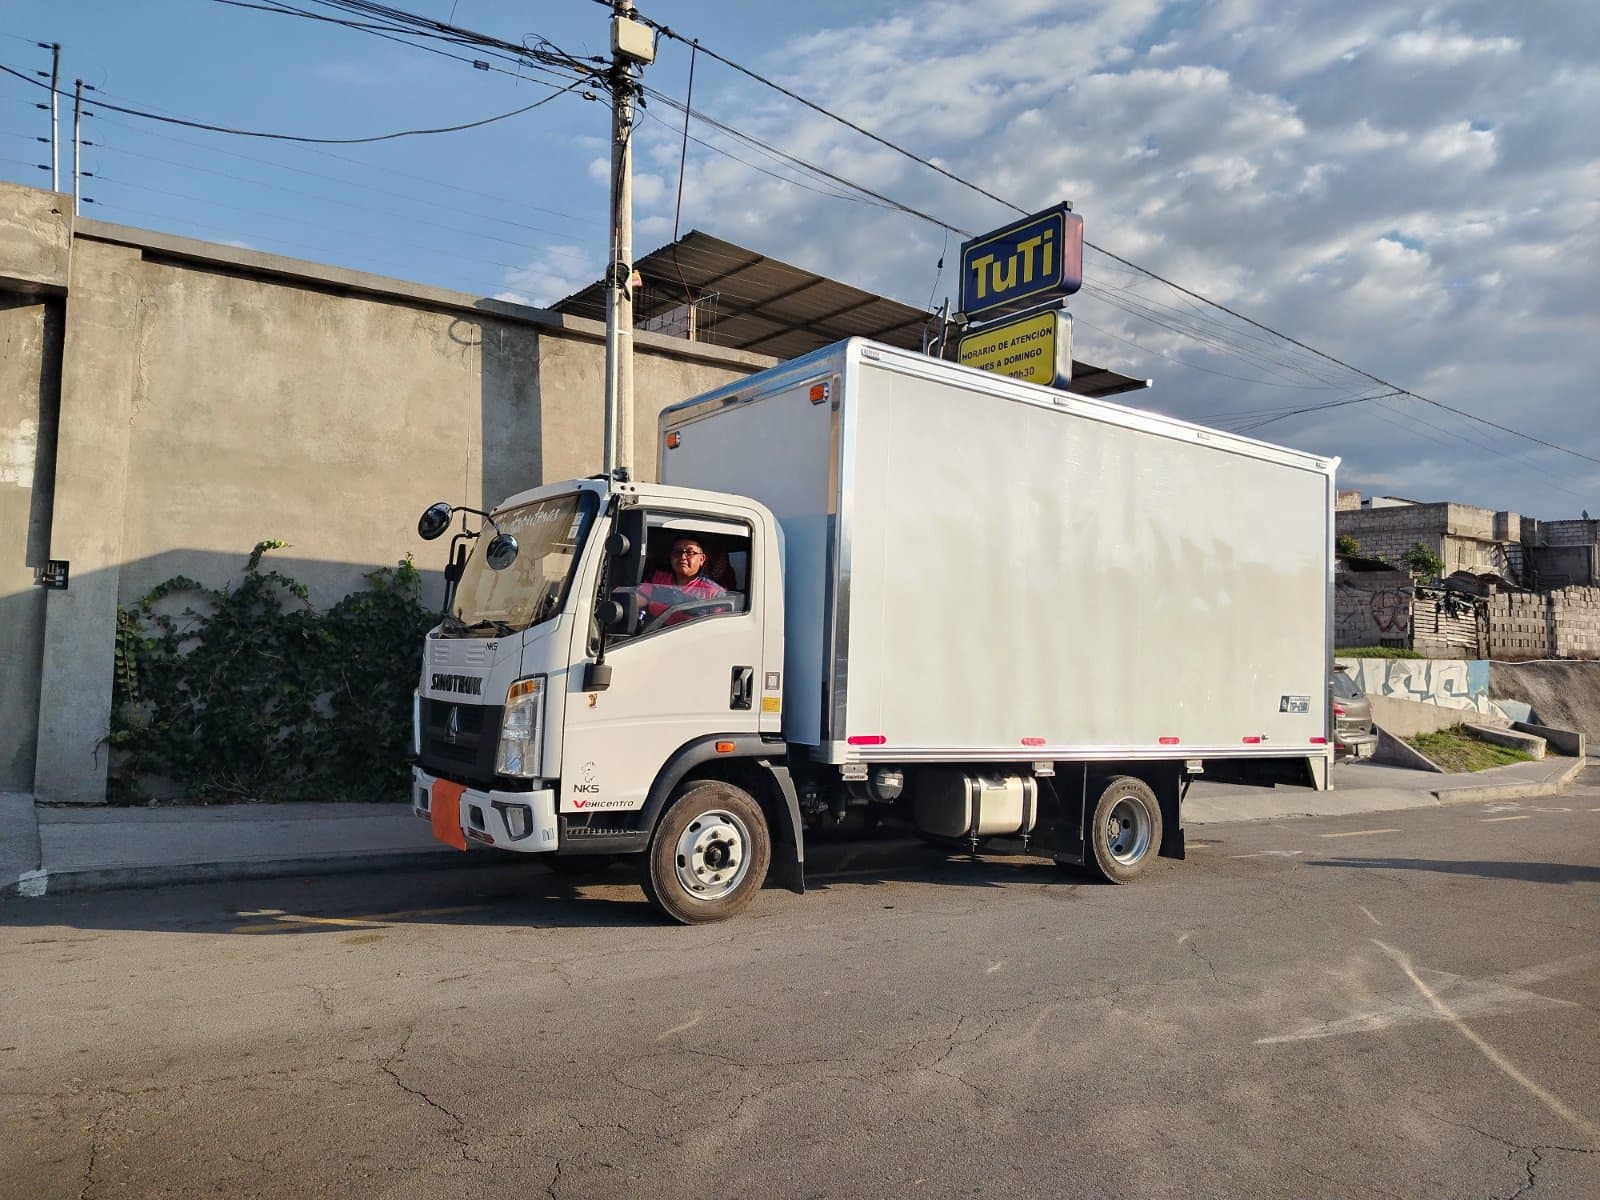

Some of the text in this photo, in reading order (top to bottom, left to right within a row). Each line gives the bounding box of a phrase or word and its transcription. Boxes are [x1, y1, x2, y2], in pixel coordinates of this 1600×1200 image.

[972, 229, 1053, 299] TuTi
[962, 345, 995, 360] HORARIO
[998, 341, 1008, 350] DE
[997, 360, 1002, 368] A
[1004, 348, 1042, 366] DOMINGO
[573, 784, 600, 793] NKS
